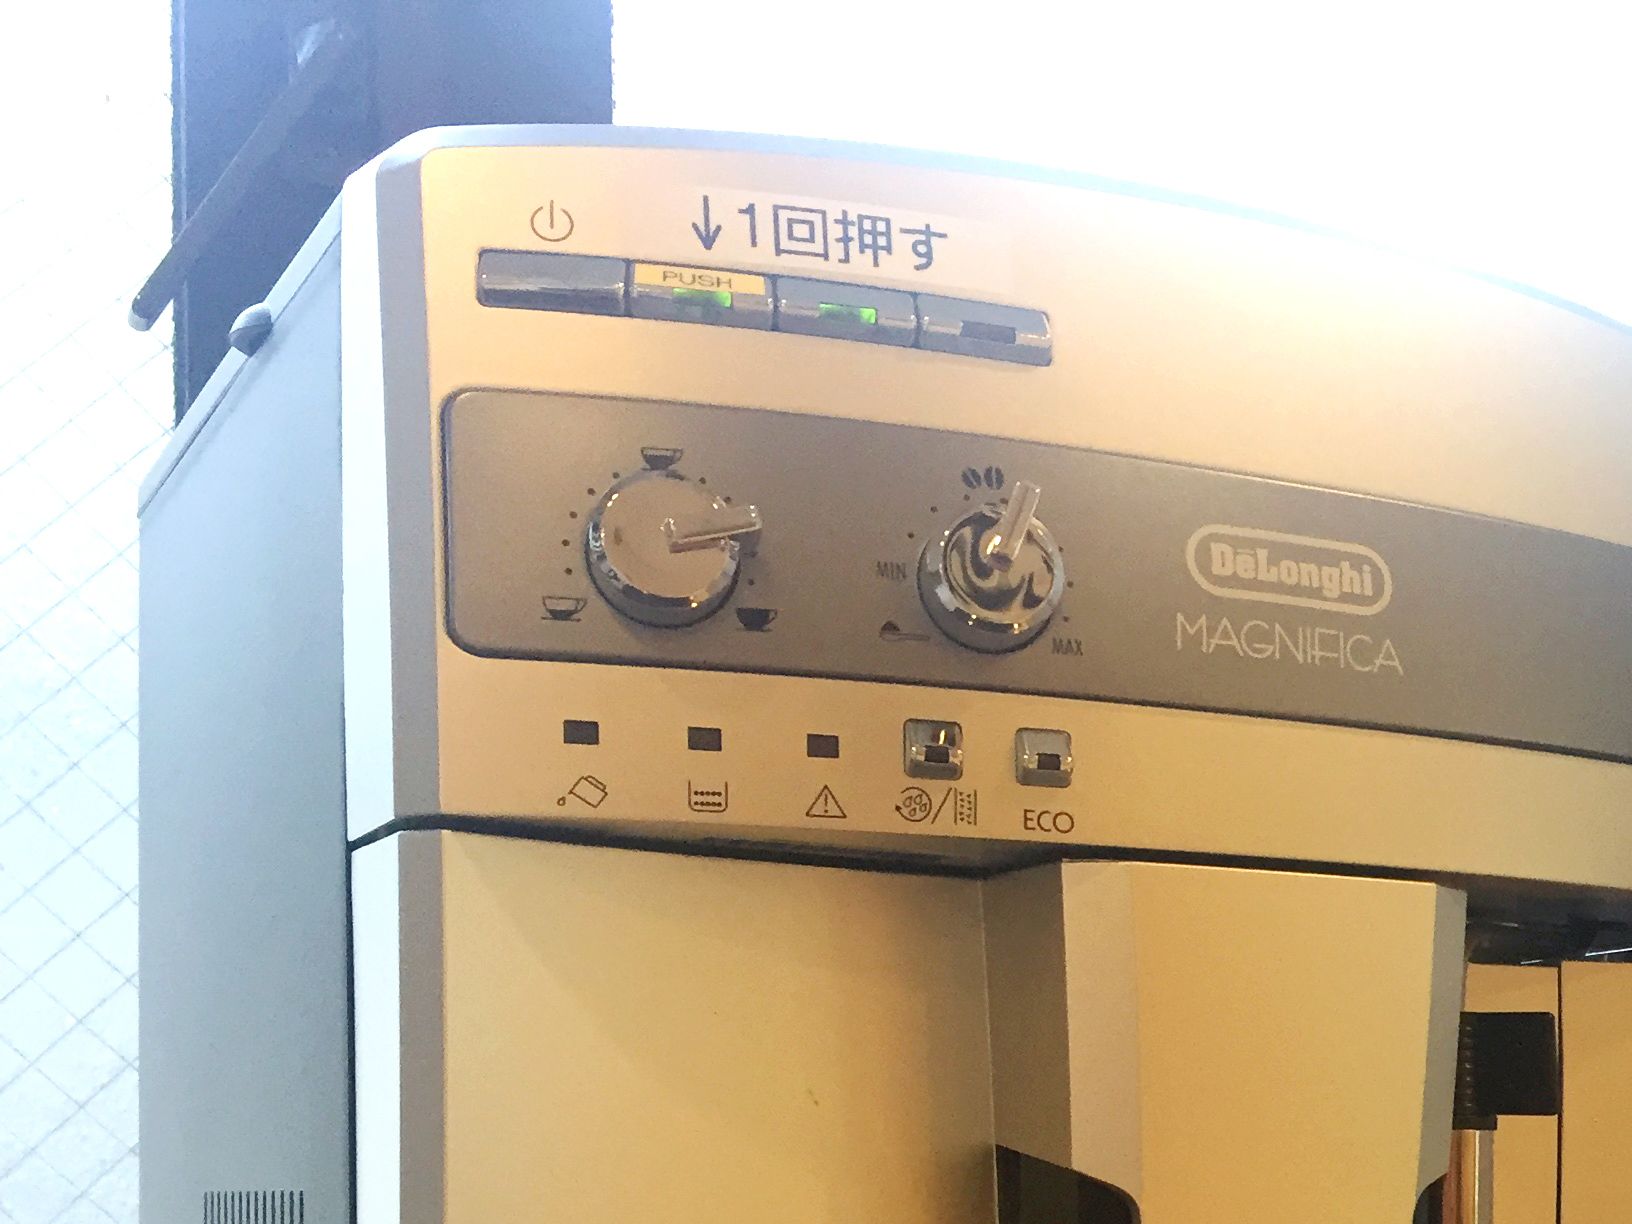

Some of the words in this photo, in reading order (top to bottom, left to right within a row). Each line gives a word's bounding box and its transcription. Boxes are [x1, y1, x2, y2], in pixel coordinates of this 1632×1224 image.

[737, 199, 949, 272] 1回押す
[661, 269, 734, 290] PUSH
[875, 560, 908, 581] MIN
[1051, 637, 1084, 656] MAX
[1174, 611, 1404, 677] MAGNIFICA
[1022, 808, 1076, 835] ECO
